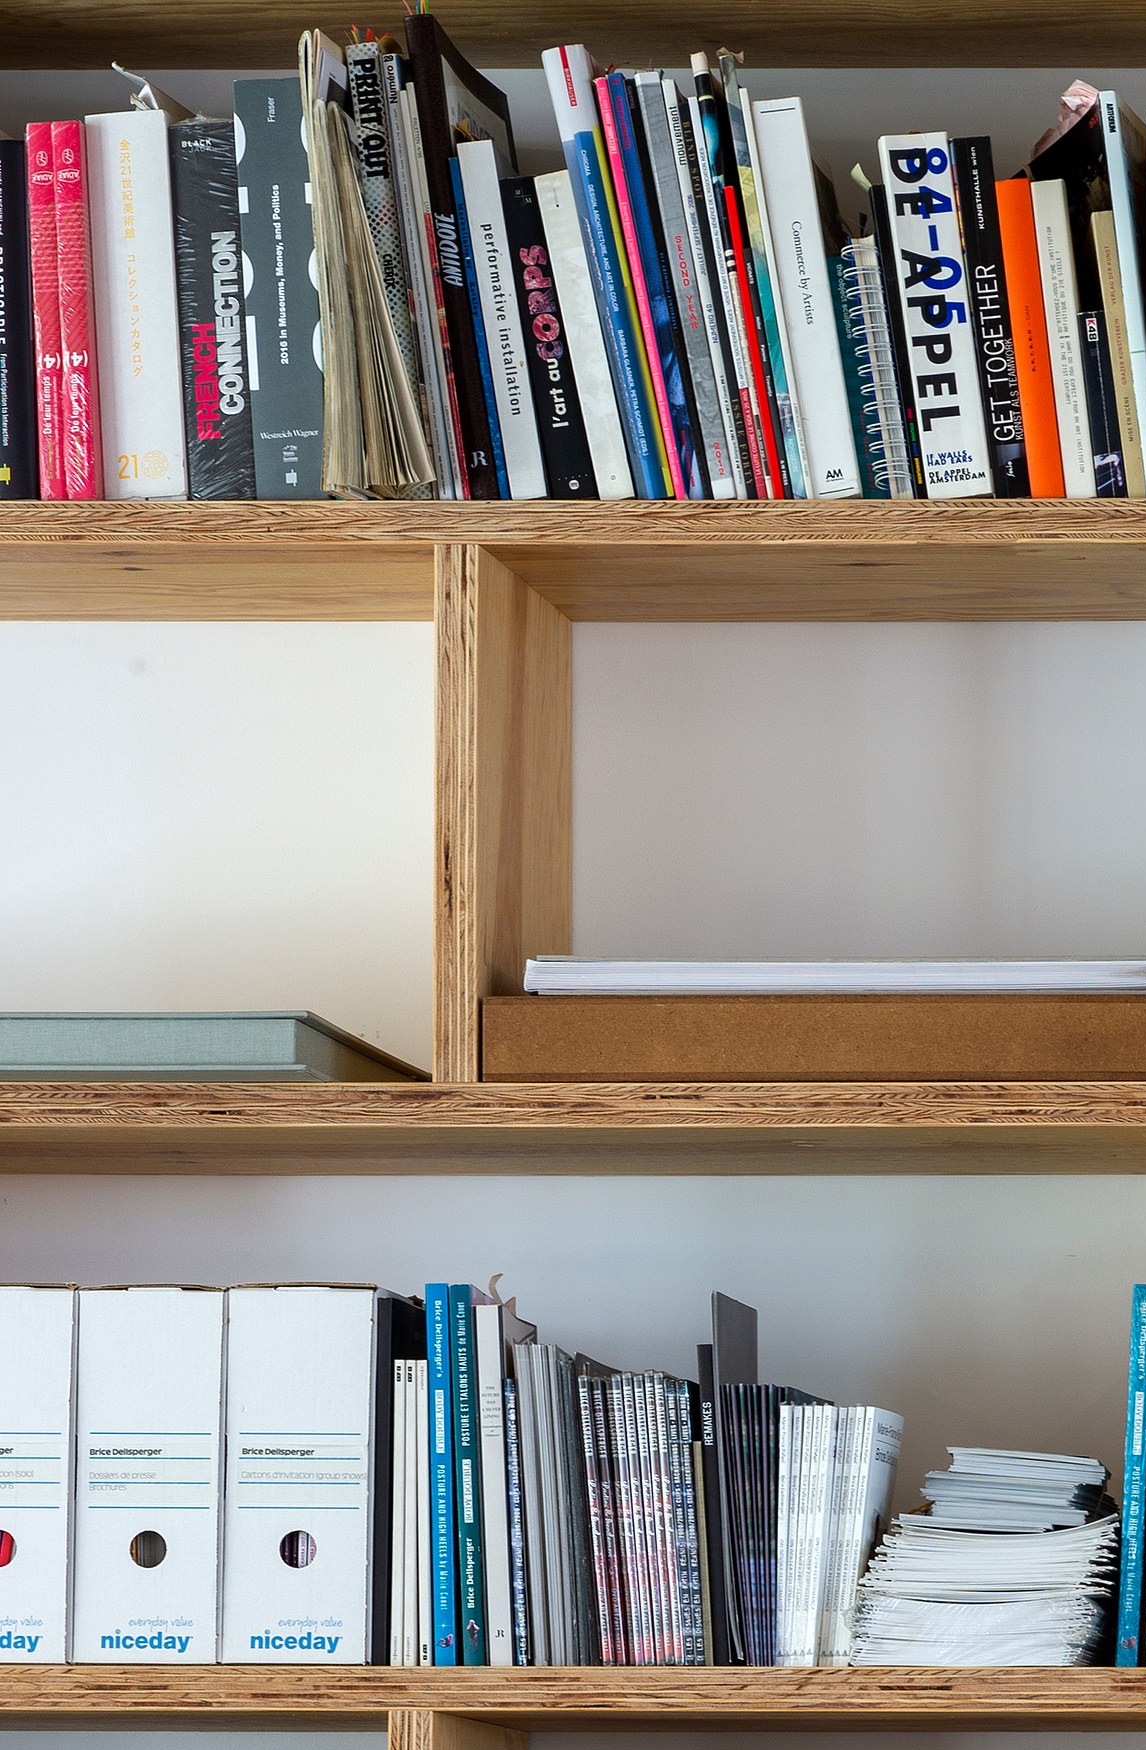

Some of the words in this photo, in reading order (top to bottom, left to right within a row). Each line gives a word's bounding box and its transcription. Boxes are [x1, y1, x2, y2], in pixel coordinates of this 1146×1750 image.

[353, 58, 390, 179] PRINT/OUT
[272, 184, 280, 220] Politics
[888, 148, 935, 217] DE
[273, 223, 282, 240] and
[792, 220, 808, 276] Commerce
[275, 242, 284, 277] Money,
[801, 276, 808, 289] by
[278, 278, 287, 328] Museums,
[480, 223, 507, 321] performative
[499, 328, 521, 416] installation
[519, 244, 564, 361] CORPS
[803, 287, 814, 326] Artists
[210, 230, 245, 415] CONNECTION
[900, 248, 961, 432] APPEL
[974, 263, 1010, 393] TOGETHER
[281, 341, 289, 365] 2016
[547, 358, 562, 382] au
[192, 322, 221, 440] FRENCH
[988, 398, 1015, 441] GET
[89, 1448, 111, 1457] Brice
[112, 1448, 162, 1458] Dellsperger
[242, 1448, 264, 1456] Brice
[265, 1448, 315, 1458] Dellsperger
[101, 1629, 191, 1654] niceday
[128, 1616, 168, 1632] everyday
[170, 1617, 194, 1628] value
[251, 1629, 340, 1654] niceday
